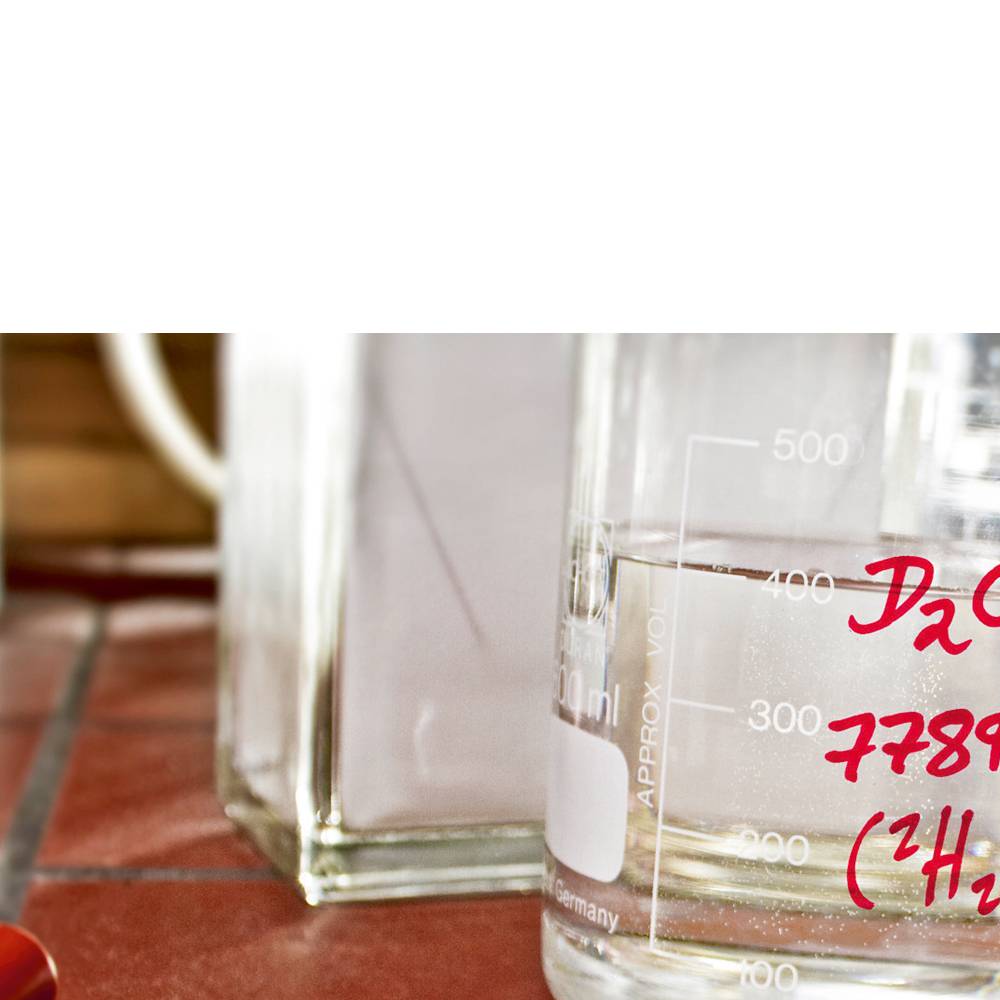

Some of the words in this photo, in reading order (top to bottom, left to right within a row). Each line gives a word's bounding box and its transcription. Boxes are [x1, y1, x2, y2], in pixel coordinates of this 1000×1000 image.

[773, 428, 849, 466] 500
[760, 567, 835, 605] 400
[587, 683, 621, 728] ml
[747, 699, 822, 736] 300
[738, 829, 811, 867] 200
[554, 878, 620, 934] Germany
[739, 959, 800, 993] 100
